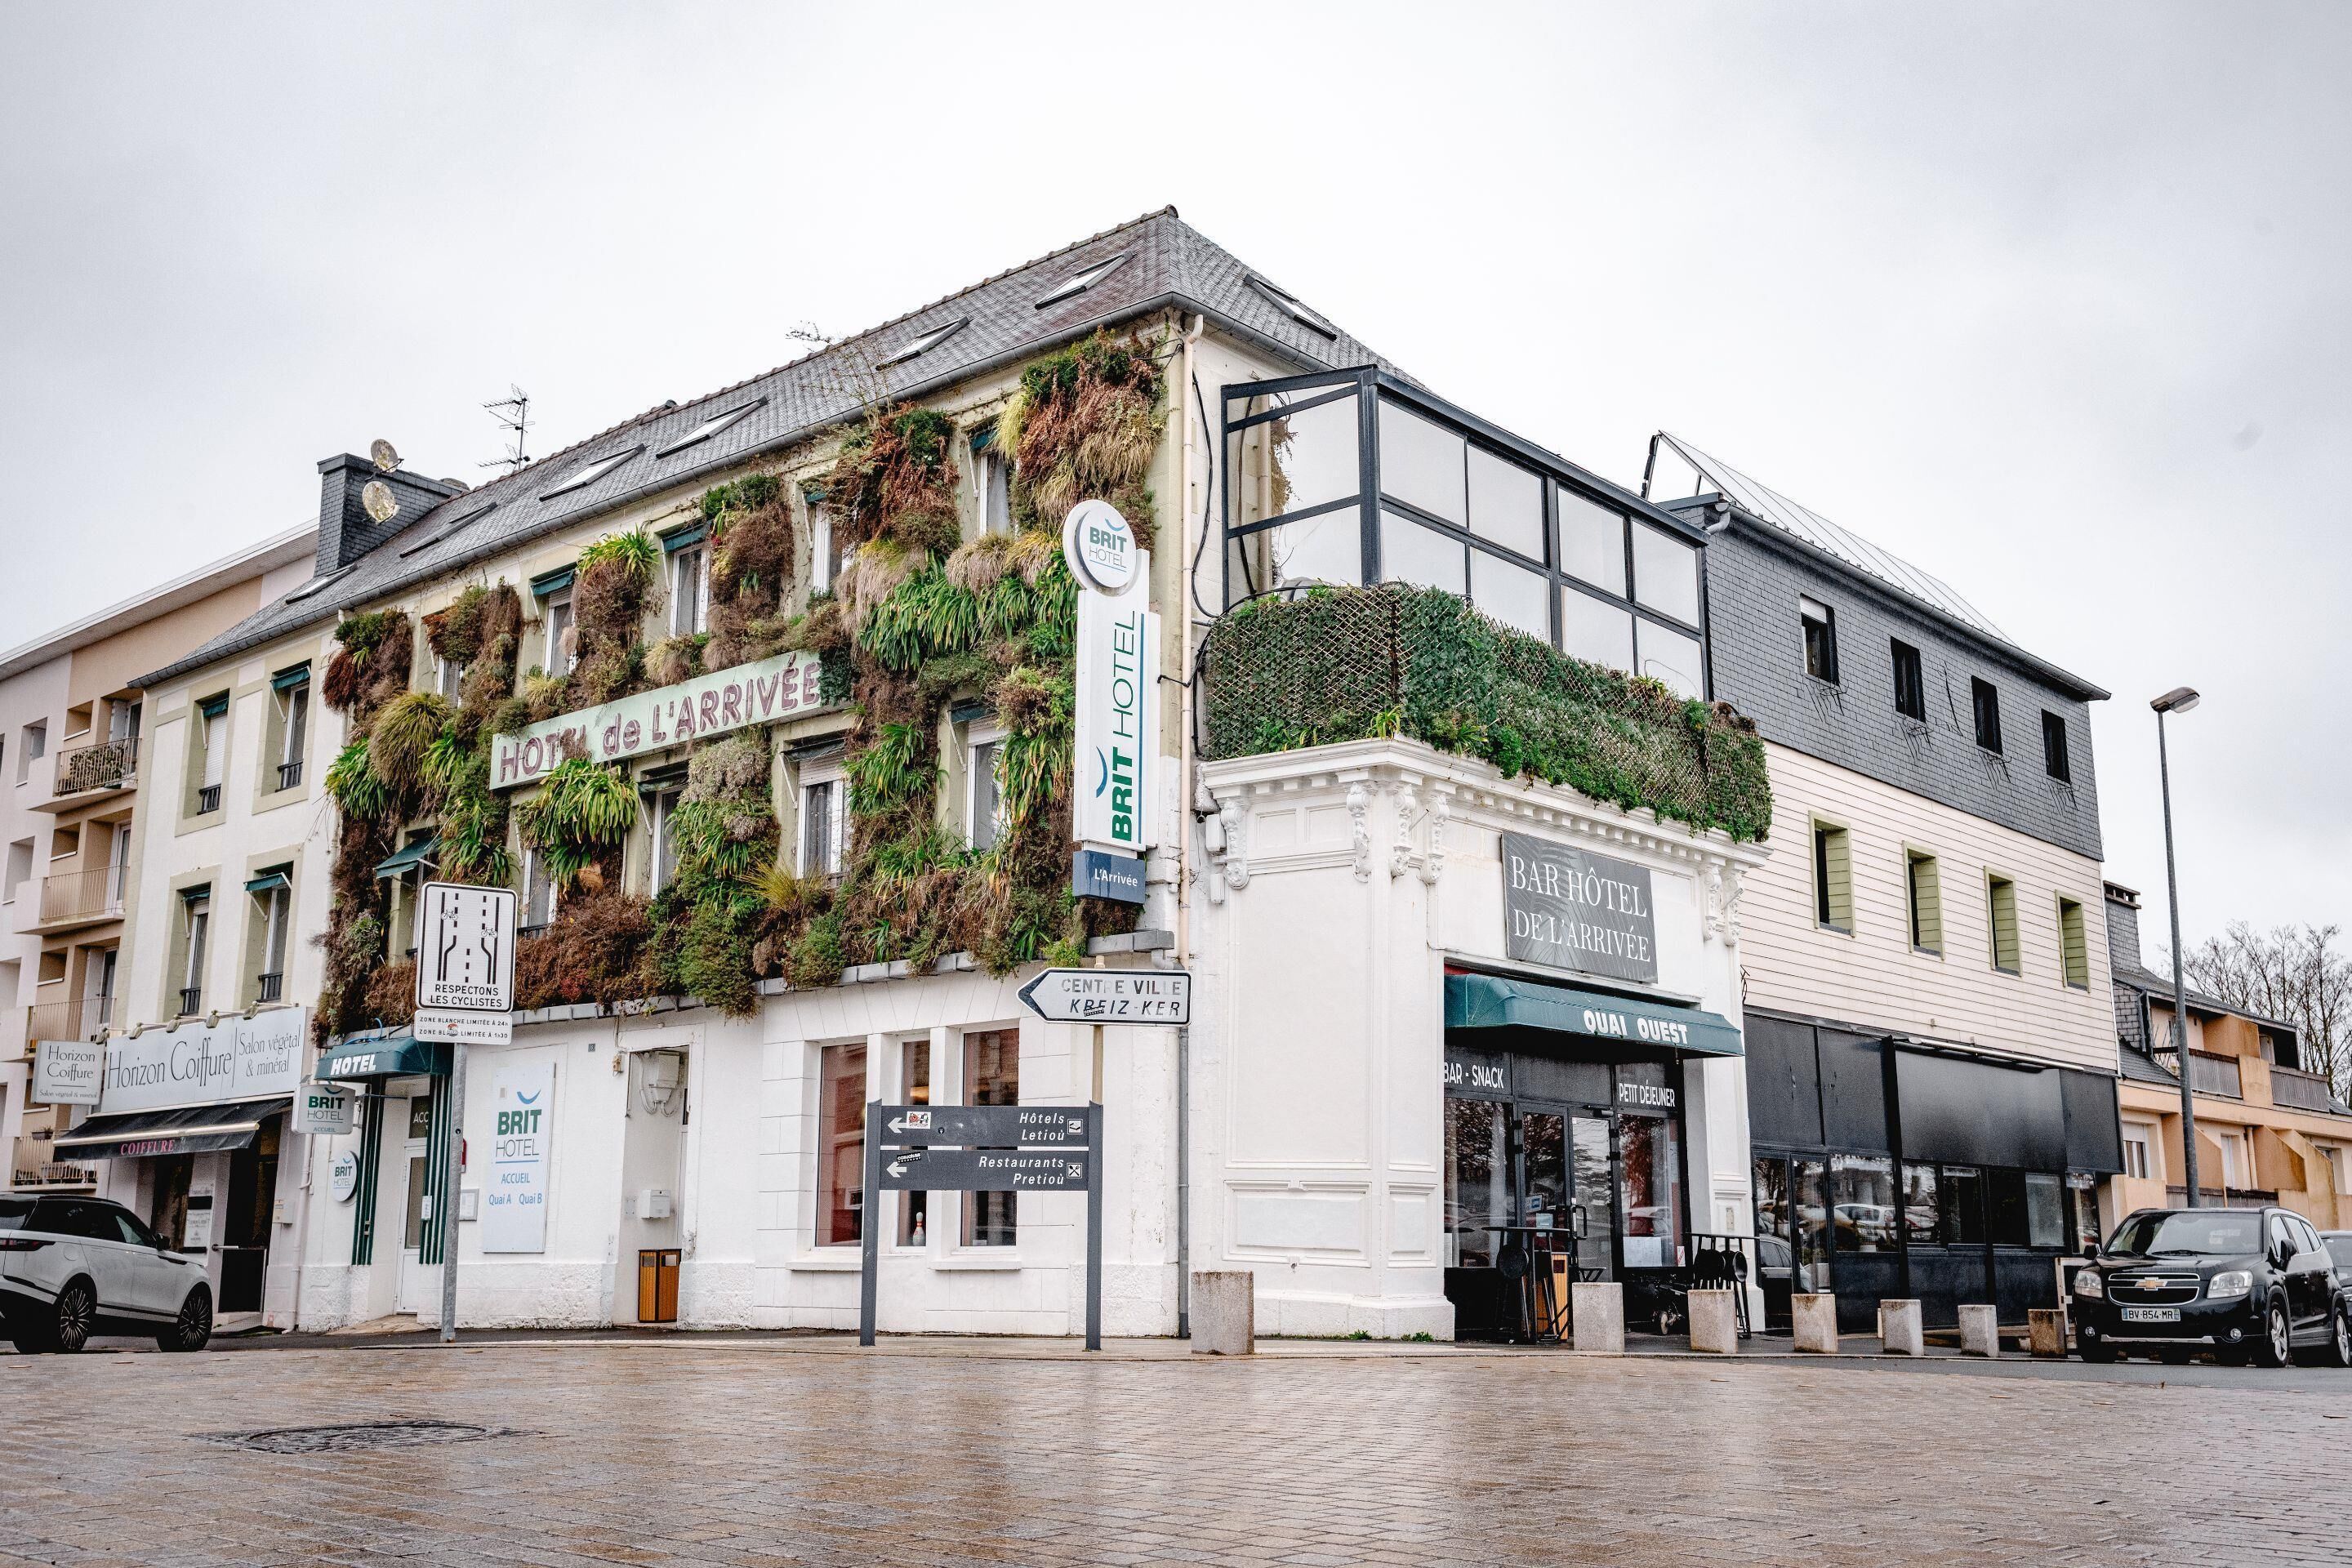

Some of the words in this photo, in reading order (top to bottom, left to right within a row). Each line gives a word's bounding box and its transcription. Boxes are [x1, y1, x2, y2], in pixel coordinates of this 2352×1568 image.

[1089, 526, 1128, 553] BRIT
[1089, 545, 1127, 568] HOTEL
[1111, 610, 1136, 738] HOTEL
[602, 712, 641, 756] de
[652, 653, 822, 744] L'ARRIVÉE
[1111, 746, 1133, 842] BRIT
[1094, 867, 1138, 887] L’Arrivée
[1511, 855, 1561, 898] BAR
[1567, 866, 1648, 918] HÔTEL
[1513, 908, 1544, 942] DE
[1549, 915, 1650, 963] L’ARRIVÉE
[435, 984, 499, 996] RESPECTONS
[1061, 978, 1125, 994] CENTRE
[1134, 980, 1182, 995] VILLE
[430, 996, 448, 1004] LES
[452, 996, 502, 1007] CYCLISTES
[1584, 1009, 1628, 1036] QUAI
[1637, 1018, 1688, 1045] OUEST
[239, 1032, 265, 1055] Salon
[268, 1024, 301, 1054] végétal
[47, 1045, 95, 1062] Horizon
[47, 1062, 93, 1081] Coiffure
[107, 1050, 165, 1090] Horizon
[170, 1037, 232, 1087] Coiffure
[246, 1062, 253, 1076] &
[256, 1050, 290, 1076] minéral
[330, 1054, 376, 1076] HOTEL
[1443, 1062, 1463, 1085] BAR
[1472, 1064, 1504, 1089] SNACK
[1619, 1082, 1638, 1102] PETIT
[1639, 1079, 1676, 1107] DÉJEUNER
[308, 1096, 345, 1109] BRIT
[307, 1110, 344, 1120] HOTEL
[497, 1109, 542, 1136] BRIT
[1019, 1112, 1065, 1124] Hôtels
[1021, 1129, 1065, 1141] Letioù
[120, 1139, 175, 1156] COIFFURE
[495, 1139, 540, 1157] HOTEL
[335, 1165, 353, 1177] BRIT
[978, 1156, 1064, 1168] Restaurants
[333, 1177, 352, 1187] HOTEL
[501, 1173, 531, 1184] ACCUEIL
[1013, 1173, 1064, 1185] Pretioù
[488, 1195, 506, 1206] Quai
[506, 1194, 512, 1204] A
[519, 1194, 536, 1205] Quai
[537, 1193, 542, 1204] B
[2128, 1310, 2173, 1320] BV-854-MR
